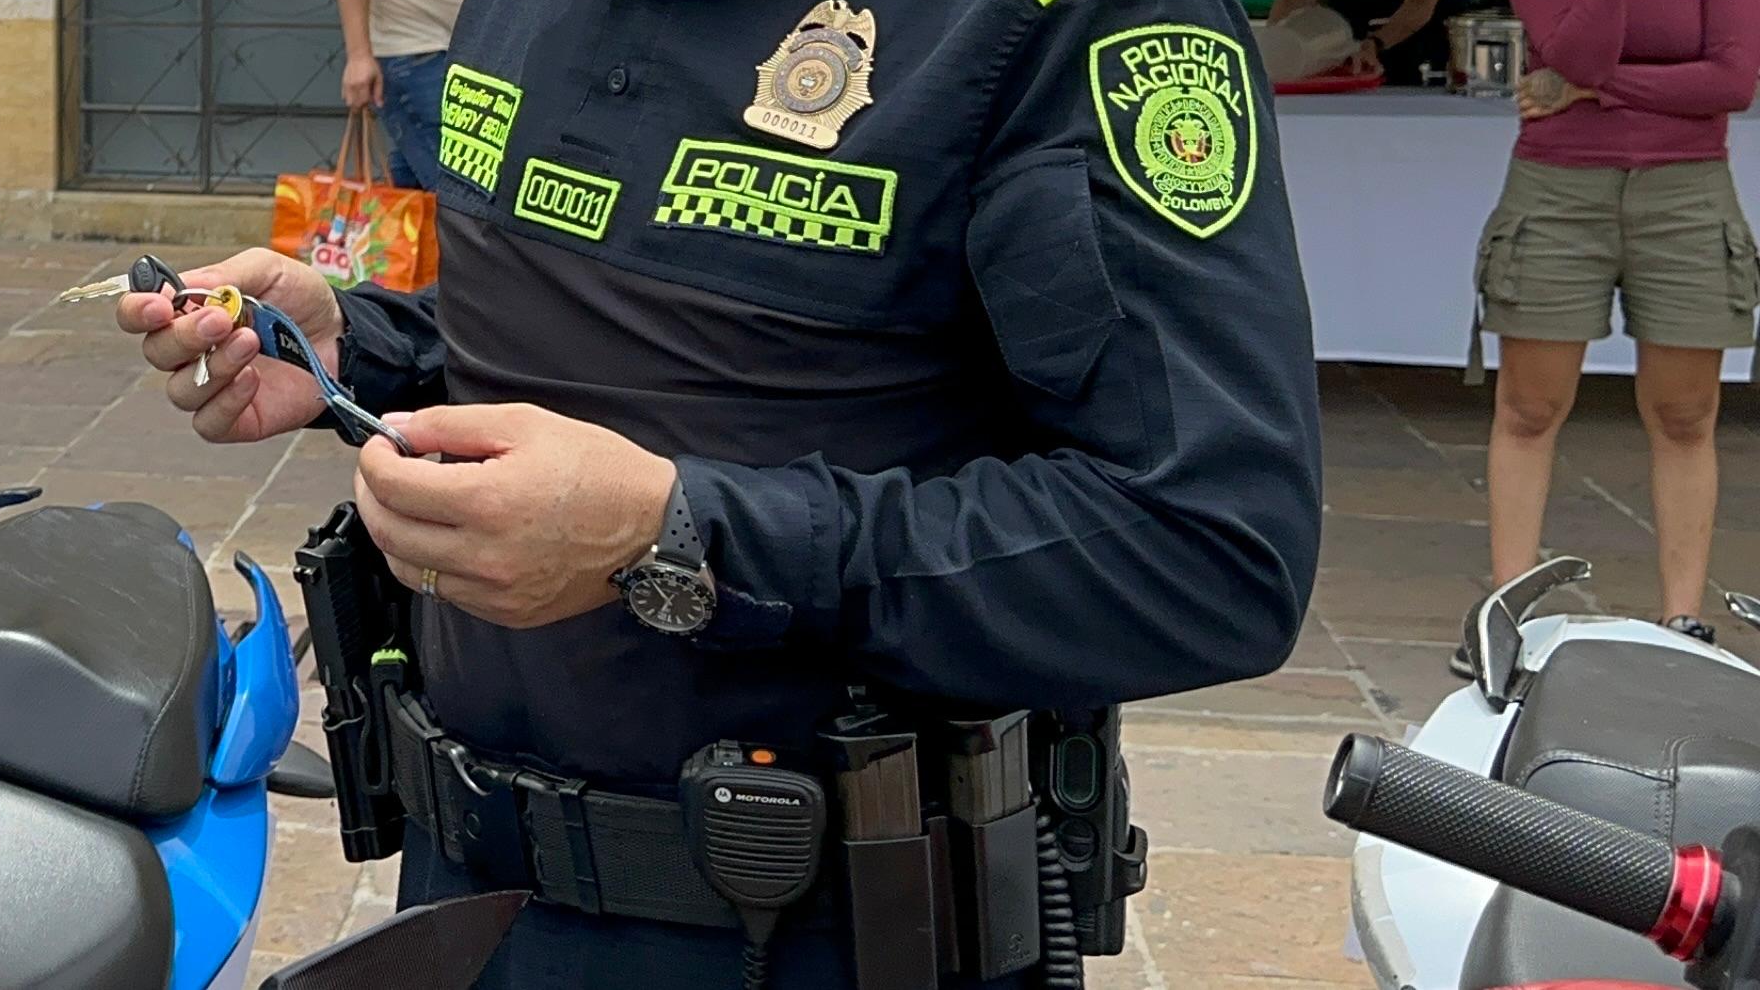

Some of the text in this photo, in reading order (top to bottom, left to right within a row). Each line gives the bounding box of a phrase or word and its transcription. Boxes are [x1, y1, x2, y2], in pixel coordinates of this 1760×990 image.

[1120, 36, 1230, 77] POLICÍA
[1107, 63, 1243, 117] NACIONAL
[761, 111, 817, 140] 000011
[525, 174, 607, 226] 000011
[686, 158, 861, 220] POLICÍA
[1160, 194, 1234, 211] COLOMBIA
[735, 793, 801, 806] MOTOROLA
